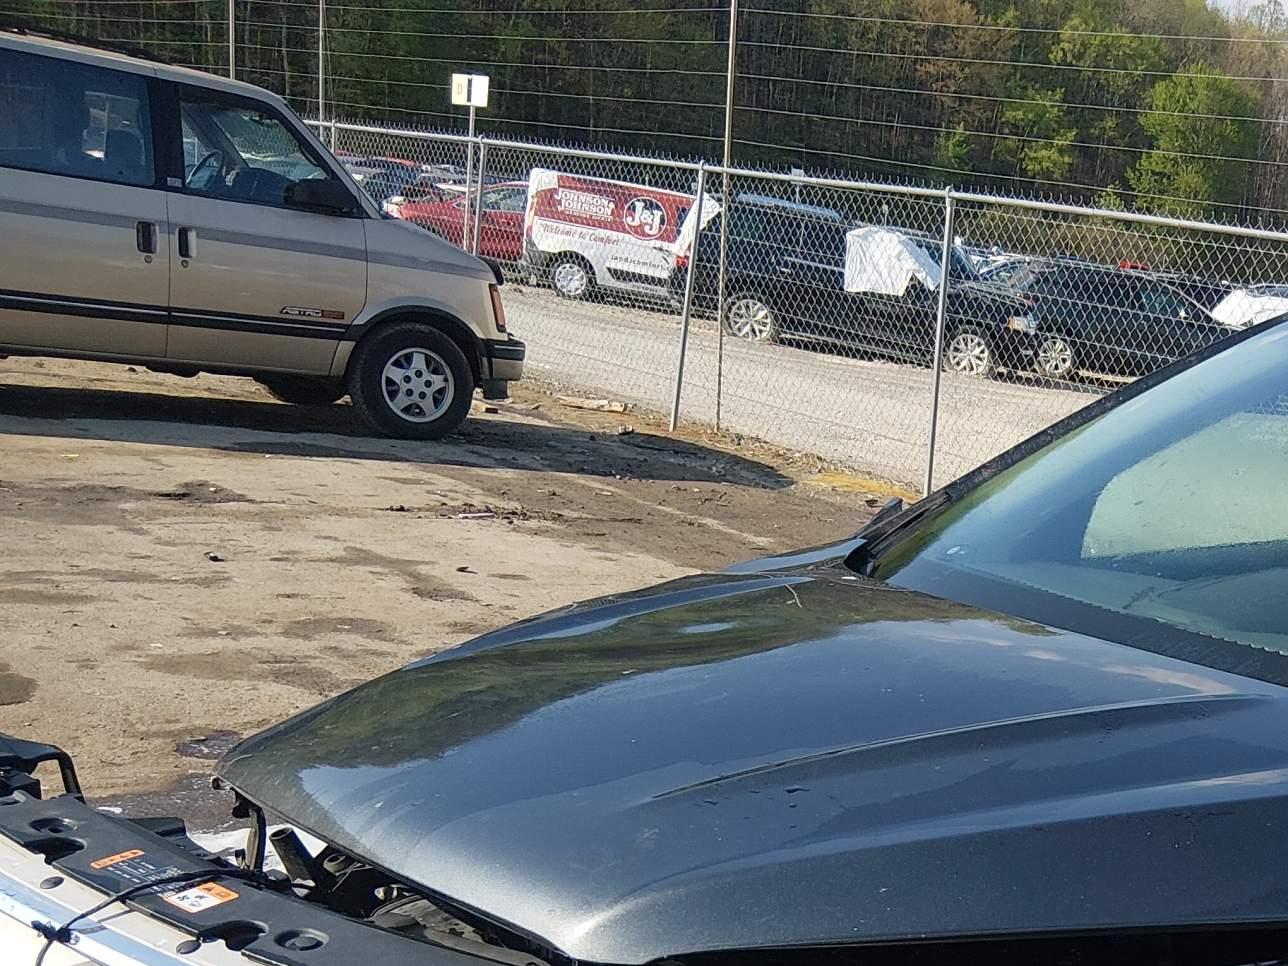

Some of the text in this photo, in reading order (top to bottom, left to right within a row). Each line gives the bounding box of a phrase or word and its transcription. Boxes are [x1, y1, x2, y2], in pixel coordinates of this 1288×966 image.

[553, 189, 609, 207] JOHNSON
[558, 199, 612, 216] JOHNSON
[626, 201, 662, 235] J&J
